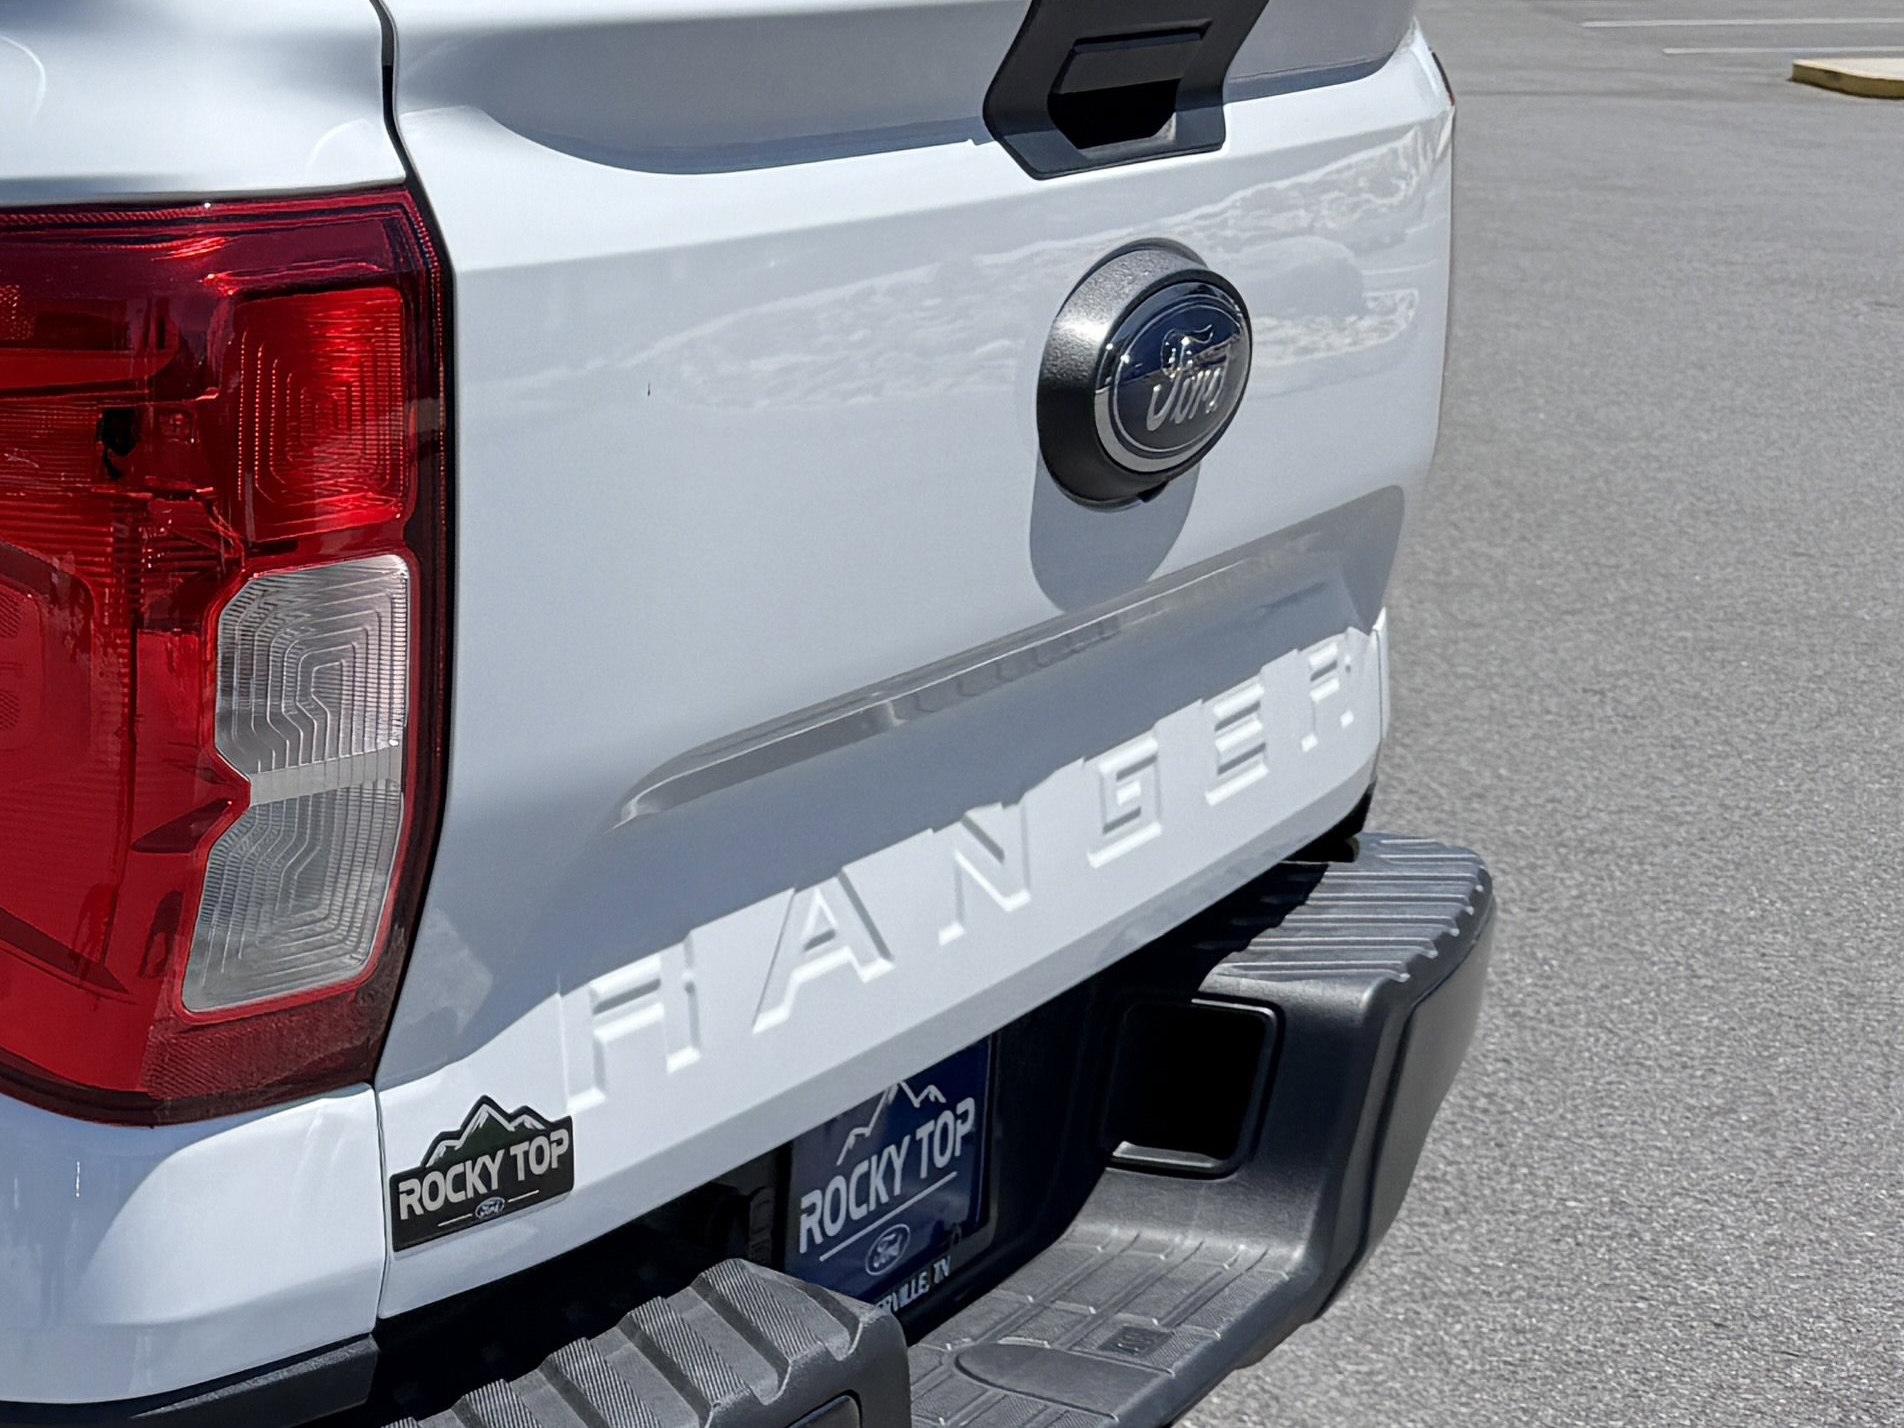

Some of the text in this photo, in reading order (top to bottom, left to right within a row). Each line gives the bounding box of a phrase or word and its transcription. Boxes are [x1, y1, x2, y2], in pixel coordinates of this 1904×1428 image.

[556, 628, 1370, 1115] RANGER
[398, 1128, 569, 1221] ROCKY TOP
[799, 1097, 975, 1254] ROCKY TOP
